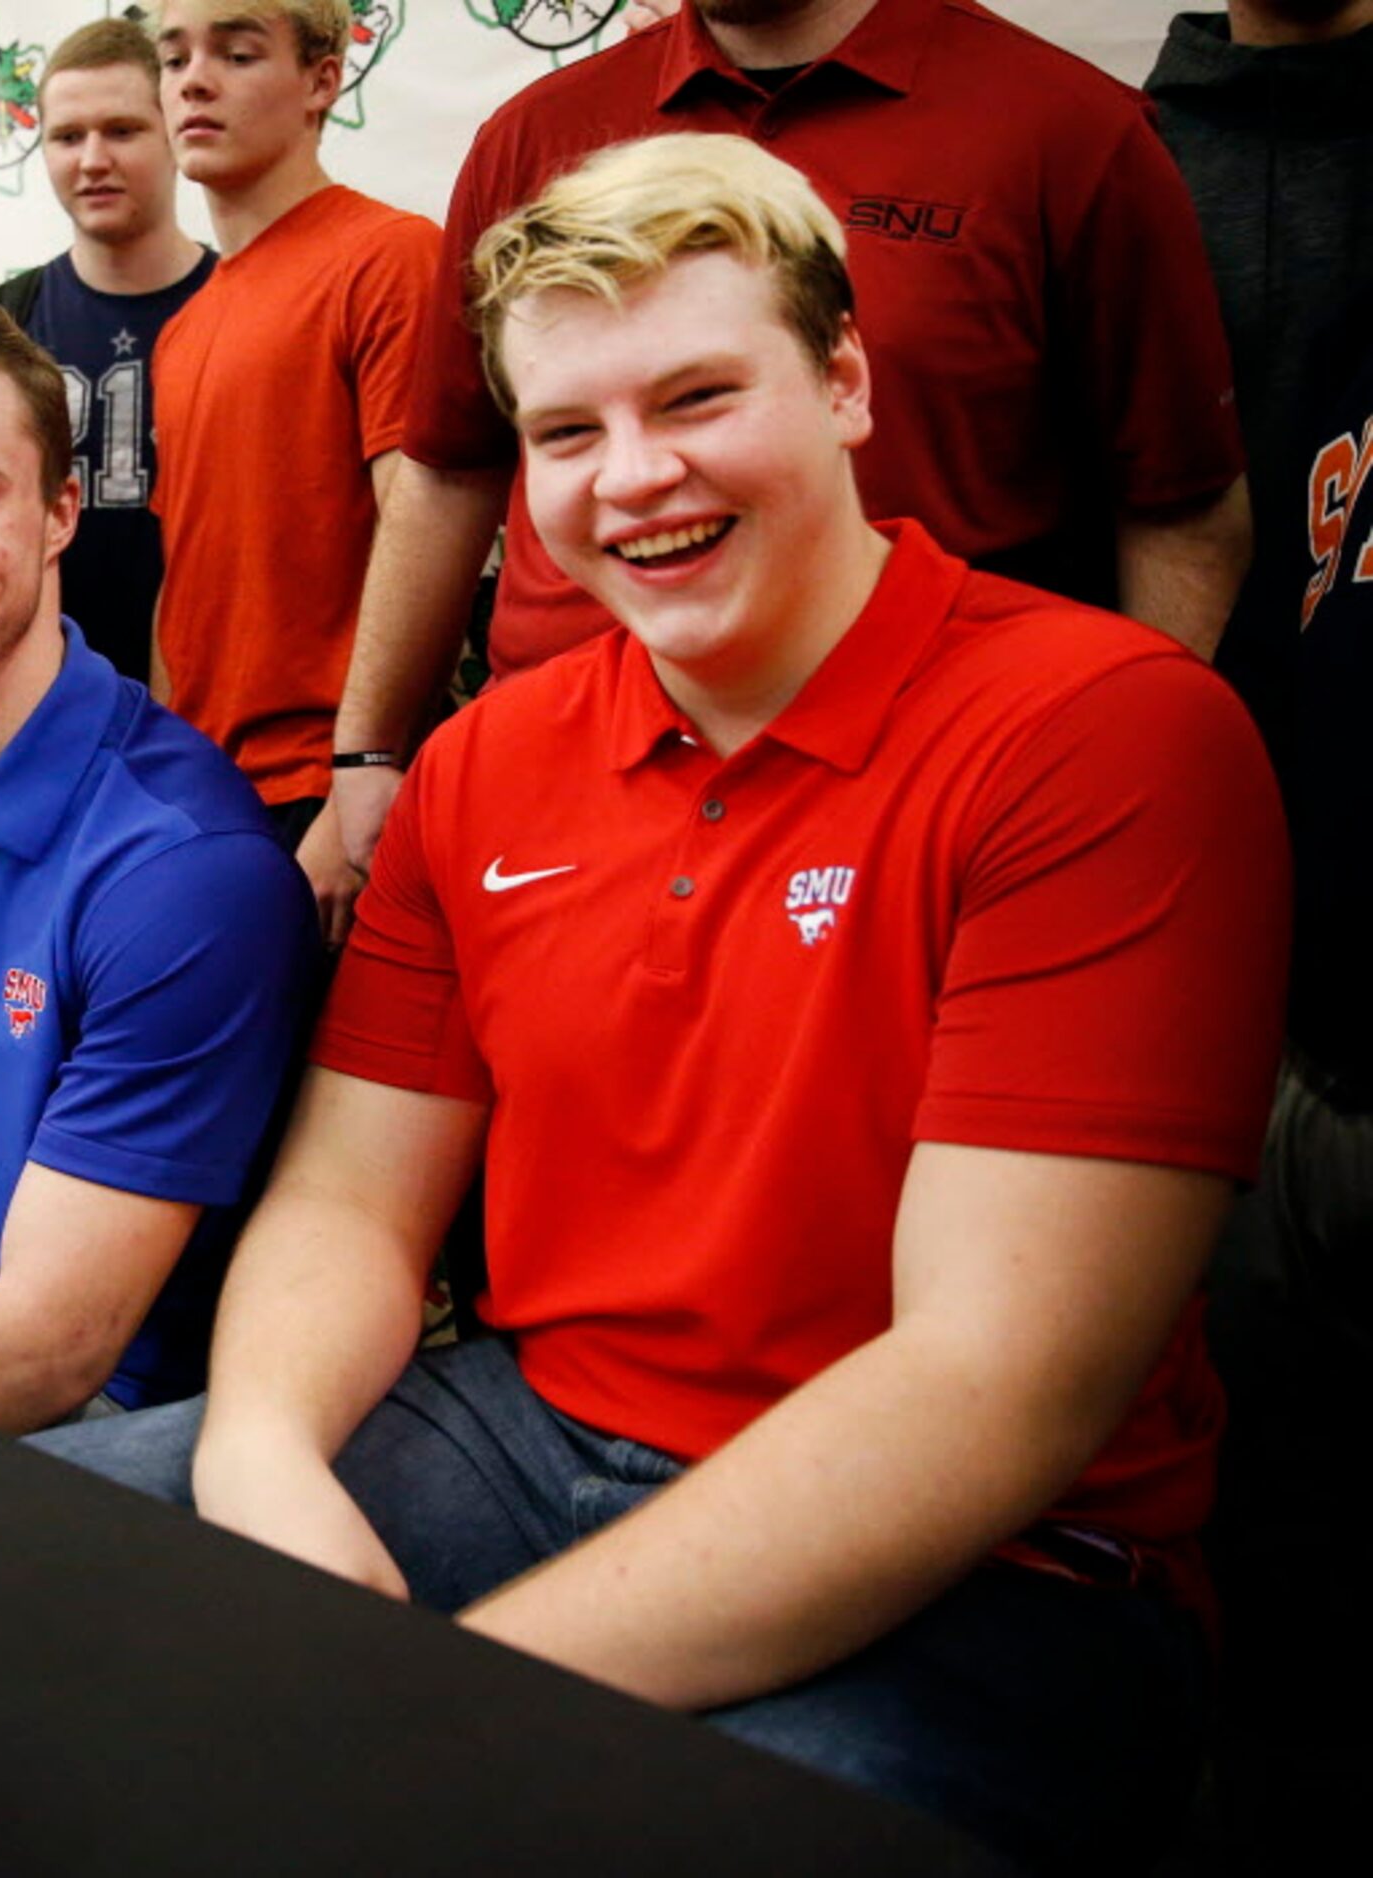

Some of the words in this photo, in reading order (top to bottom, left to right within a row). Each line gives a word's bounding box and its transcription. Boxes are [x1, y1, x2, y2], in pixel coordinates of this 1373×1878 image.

[848, 200, 963, 240] SNU
[785, 866, 856, 910] SMU
[5, 968, 46, 1013] SMU
